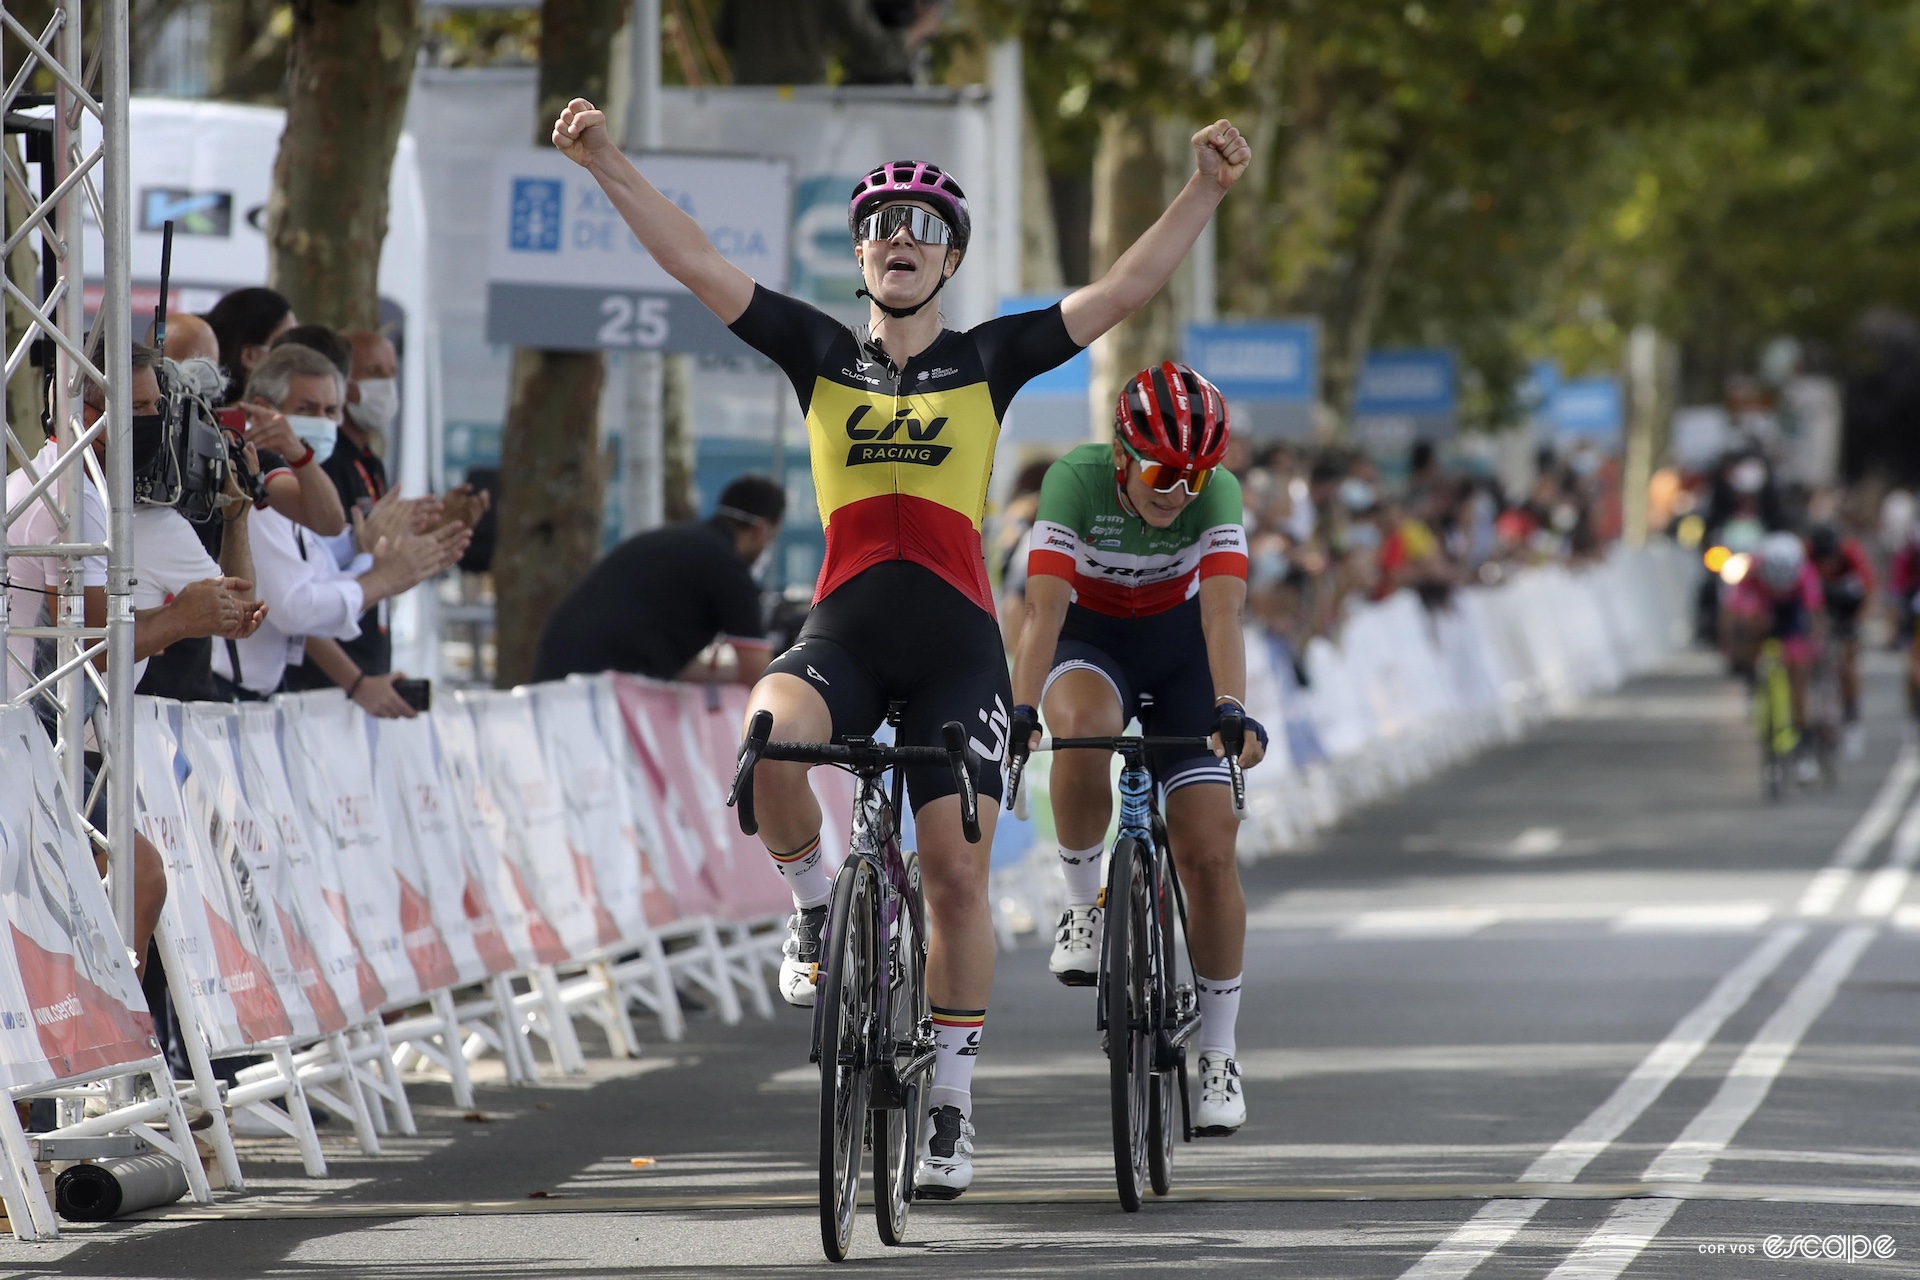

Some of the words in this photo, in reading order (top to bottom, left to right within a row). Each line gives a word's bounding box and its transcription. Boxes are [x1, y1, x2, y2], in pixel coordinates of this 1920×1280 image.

[573, 221, 616, 250] DE
[597, 294, 670, 347] 25
[841, 367, 881, 386] CUORE
[846, 405, 949, 442] Liv
[862, 447, 932, 461] RACING
[1084, 553, 1187, 578] TREK
[968, 692, 1008, 762] Liv
